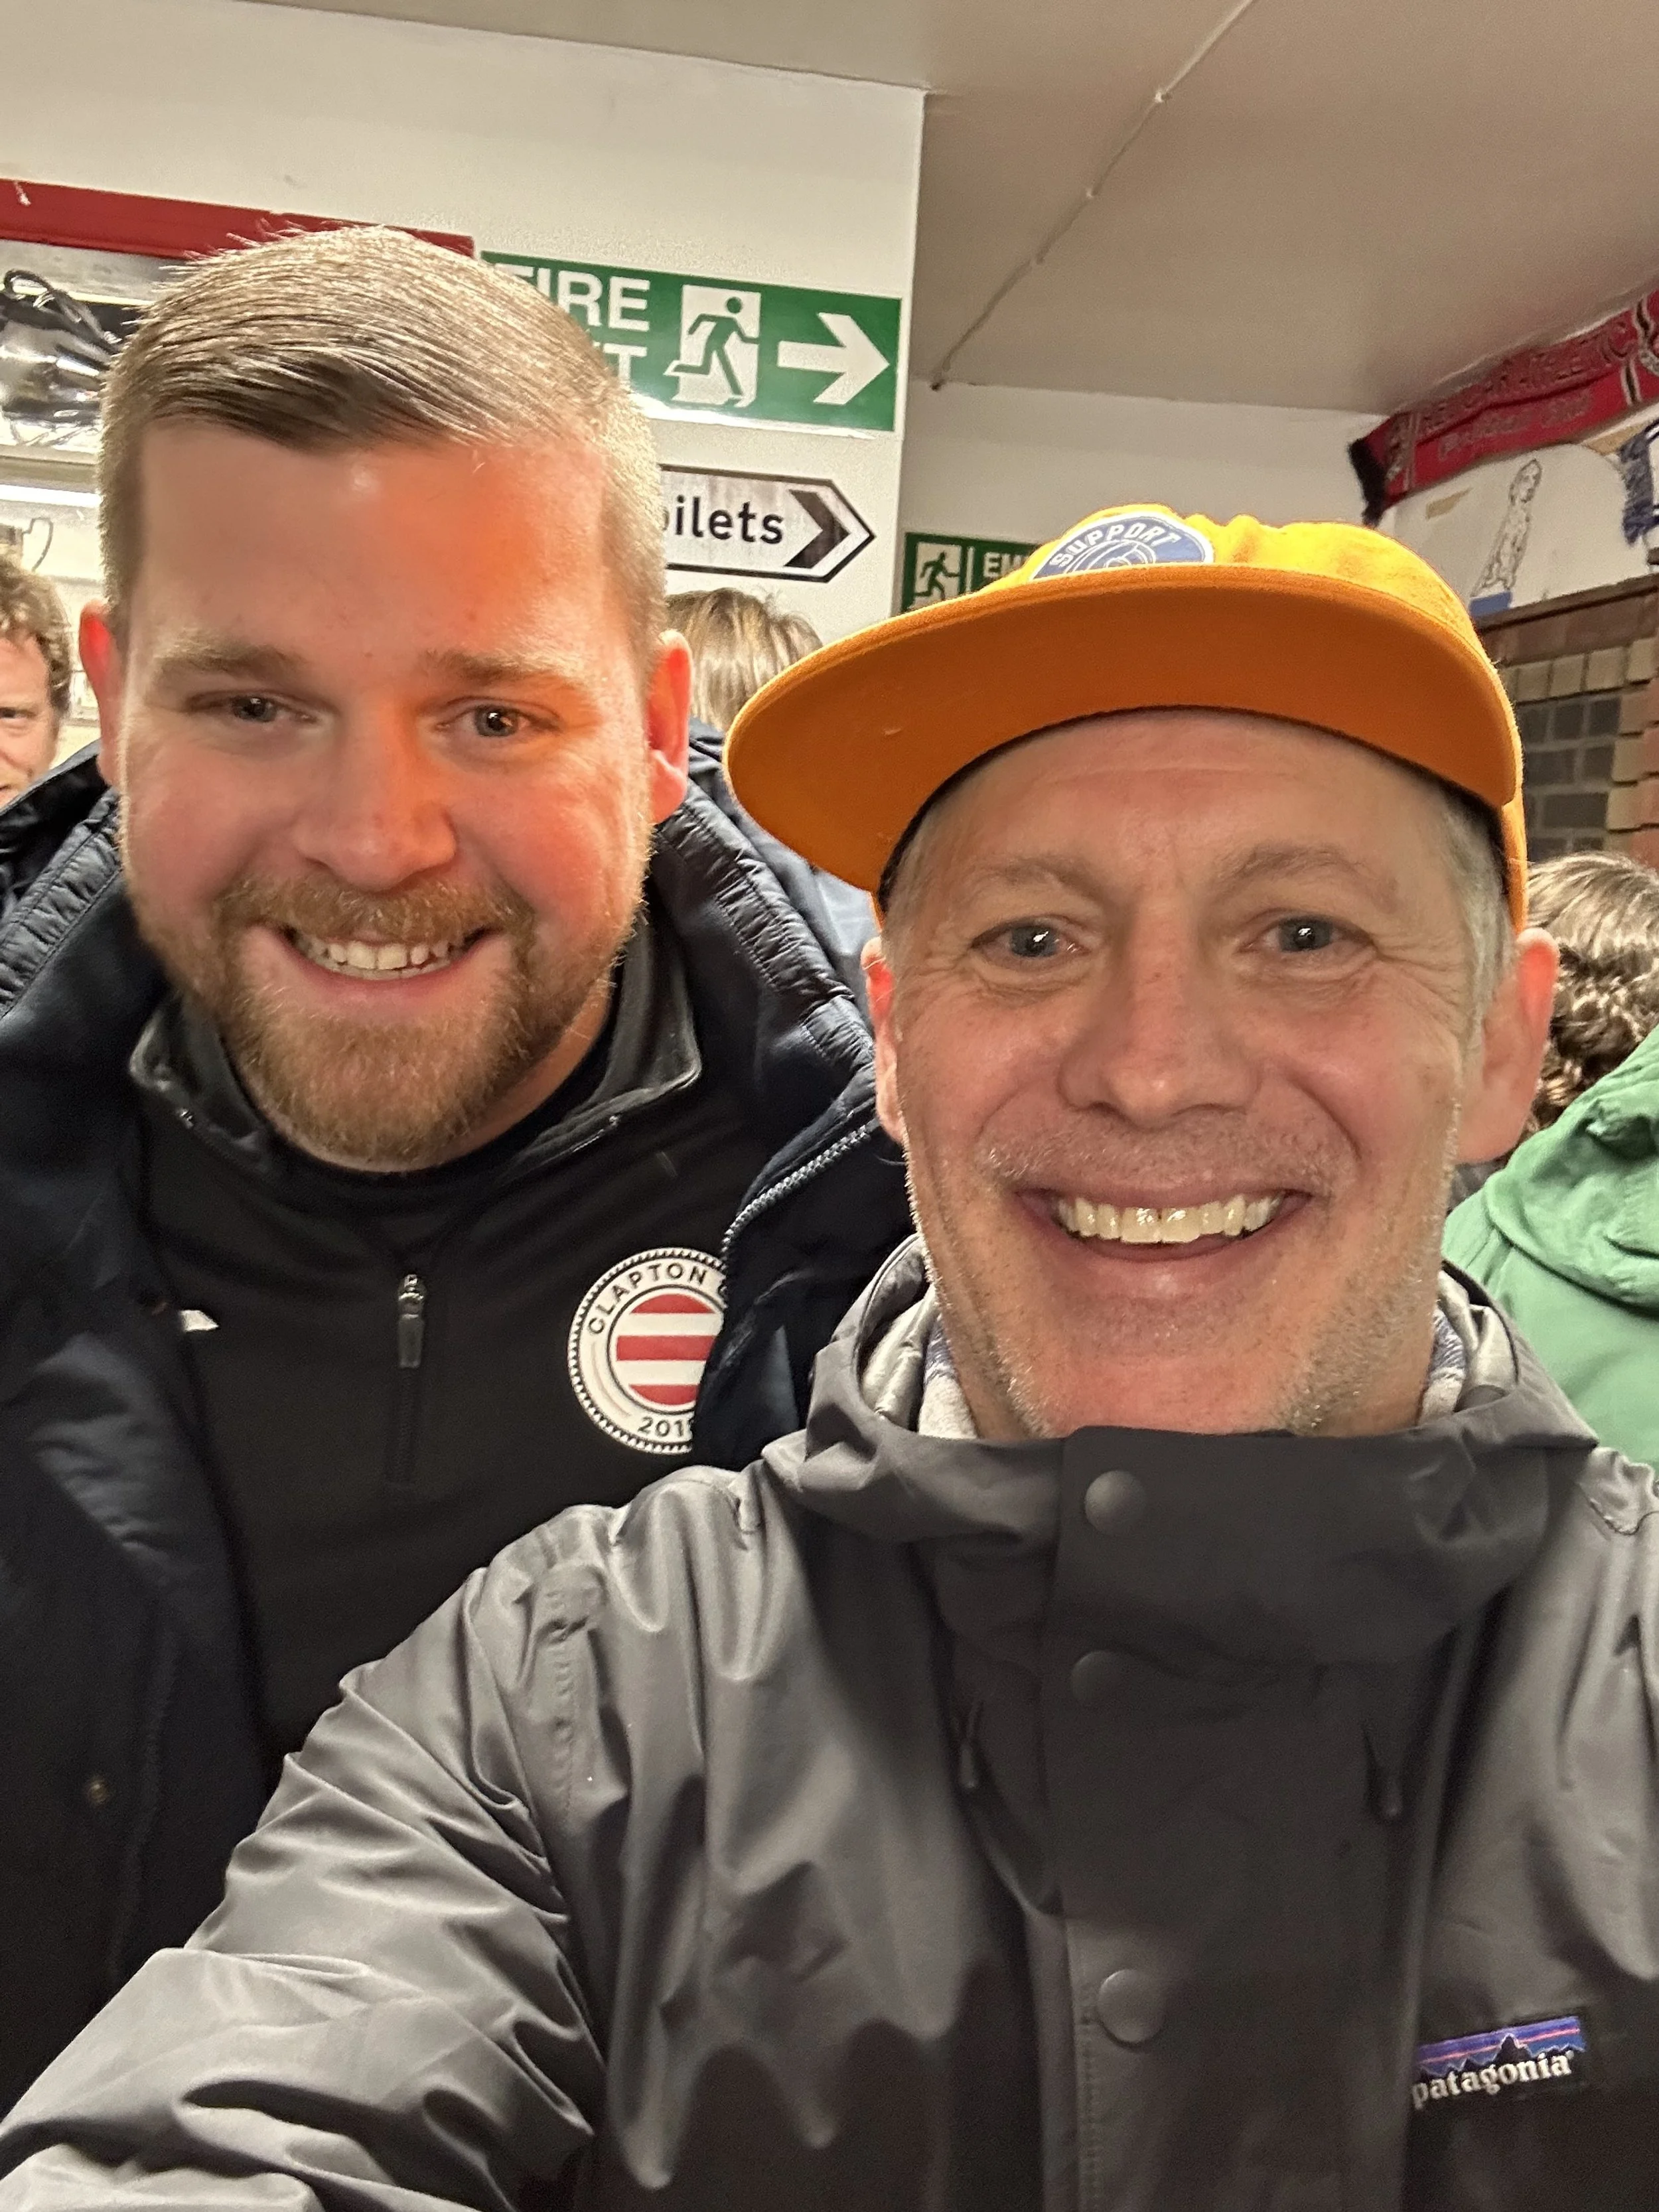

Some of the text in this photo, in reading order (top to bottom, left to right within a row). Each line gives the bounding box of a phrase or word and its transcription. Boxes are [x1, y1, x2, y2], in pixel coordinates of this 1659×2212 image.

[662, 495, 784, 544] ilets
[1050, 522, 1181, 568] SUPPORT
[588, 1262, 707, 1334] CLAPTON
[637, 1416, 692, 1438] 201
[1411, 2051, 1573, 2110] patagonia
